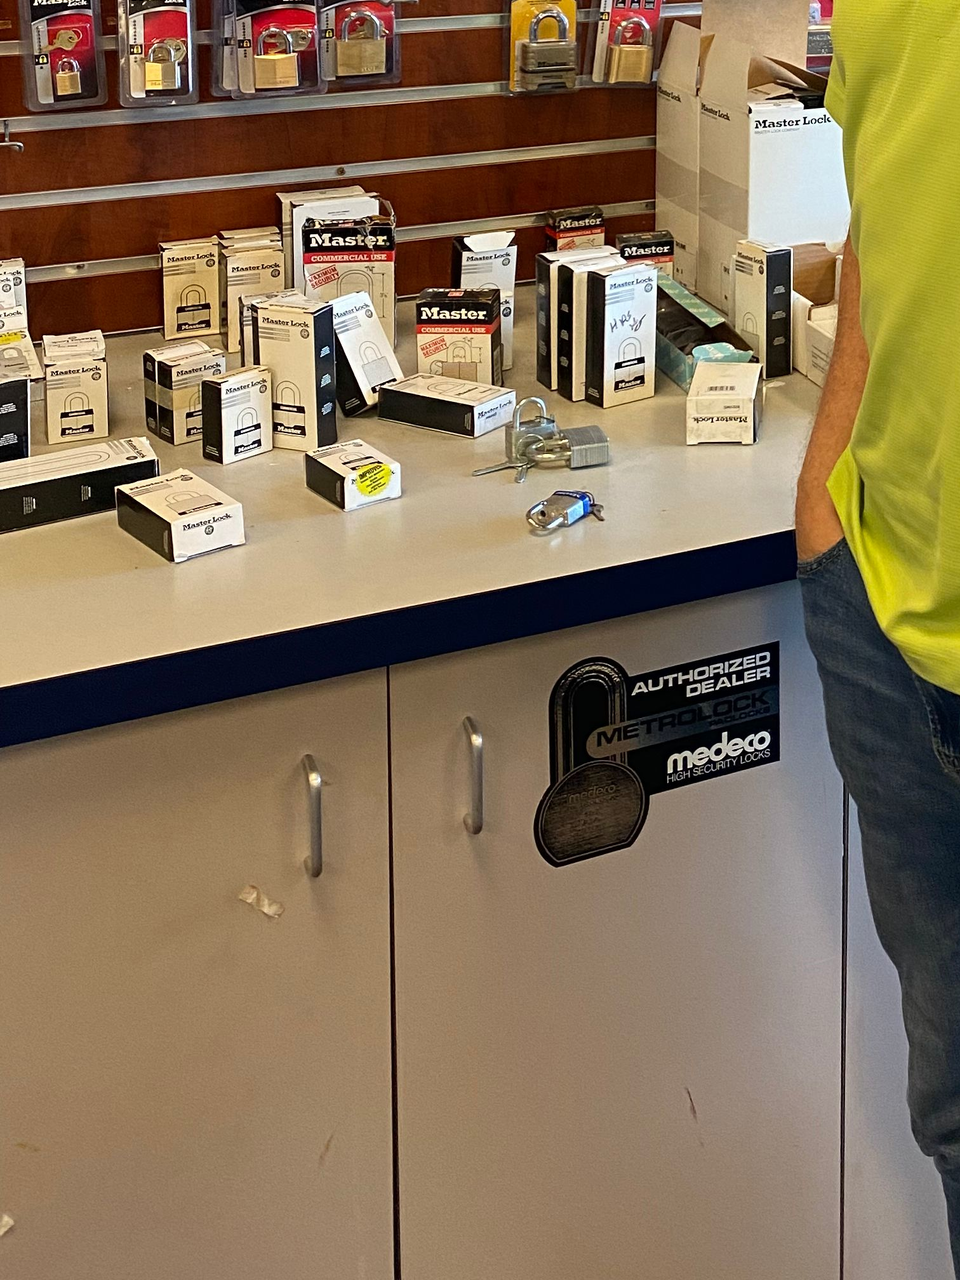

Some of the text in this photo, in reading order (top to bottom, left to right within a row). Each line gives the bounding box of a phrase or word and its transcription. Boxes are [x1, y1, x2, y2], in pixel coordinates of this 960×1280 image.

[755, 115, 831, 129] Master Lock
[560, 218, 602, 229] Master
[309, 233, 387, 248] Master
[466, 254, 493, 262] Master
[624, 245, 670, 257] Master
[609, 277, 653, 290] Master Lock
[333, 303, 370, 320] Master Lock
[420, 307, 486, 320] Master
[262, 317, 309, 328] Master Lock
[420, 337, 446, 352] MAXIMUM
[423, 343, 448, 358] SECURITY
[51, 368, 80, 377] Master
[176, 362, 221, 377] Master Lock
[225, 377, 268, 394] Master Lock
[277, 425, 302, 434] Master
[182, 512, 232, 531] Master Lock
[631, 651, 771, 696] AUTHORIZED
[686, 666, 771, 697] DEALER
[596, 691, 770, 747] METROLOCK
[667, 731, 771, 774] medeco
[667, 748, 771, 784] HIGH SECURITY LOCKS
